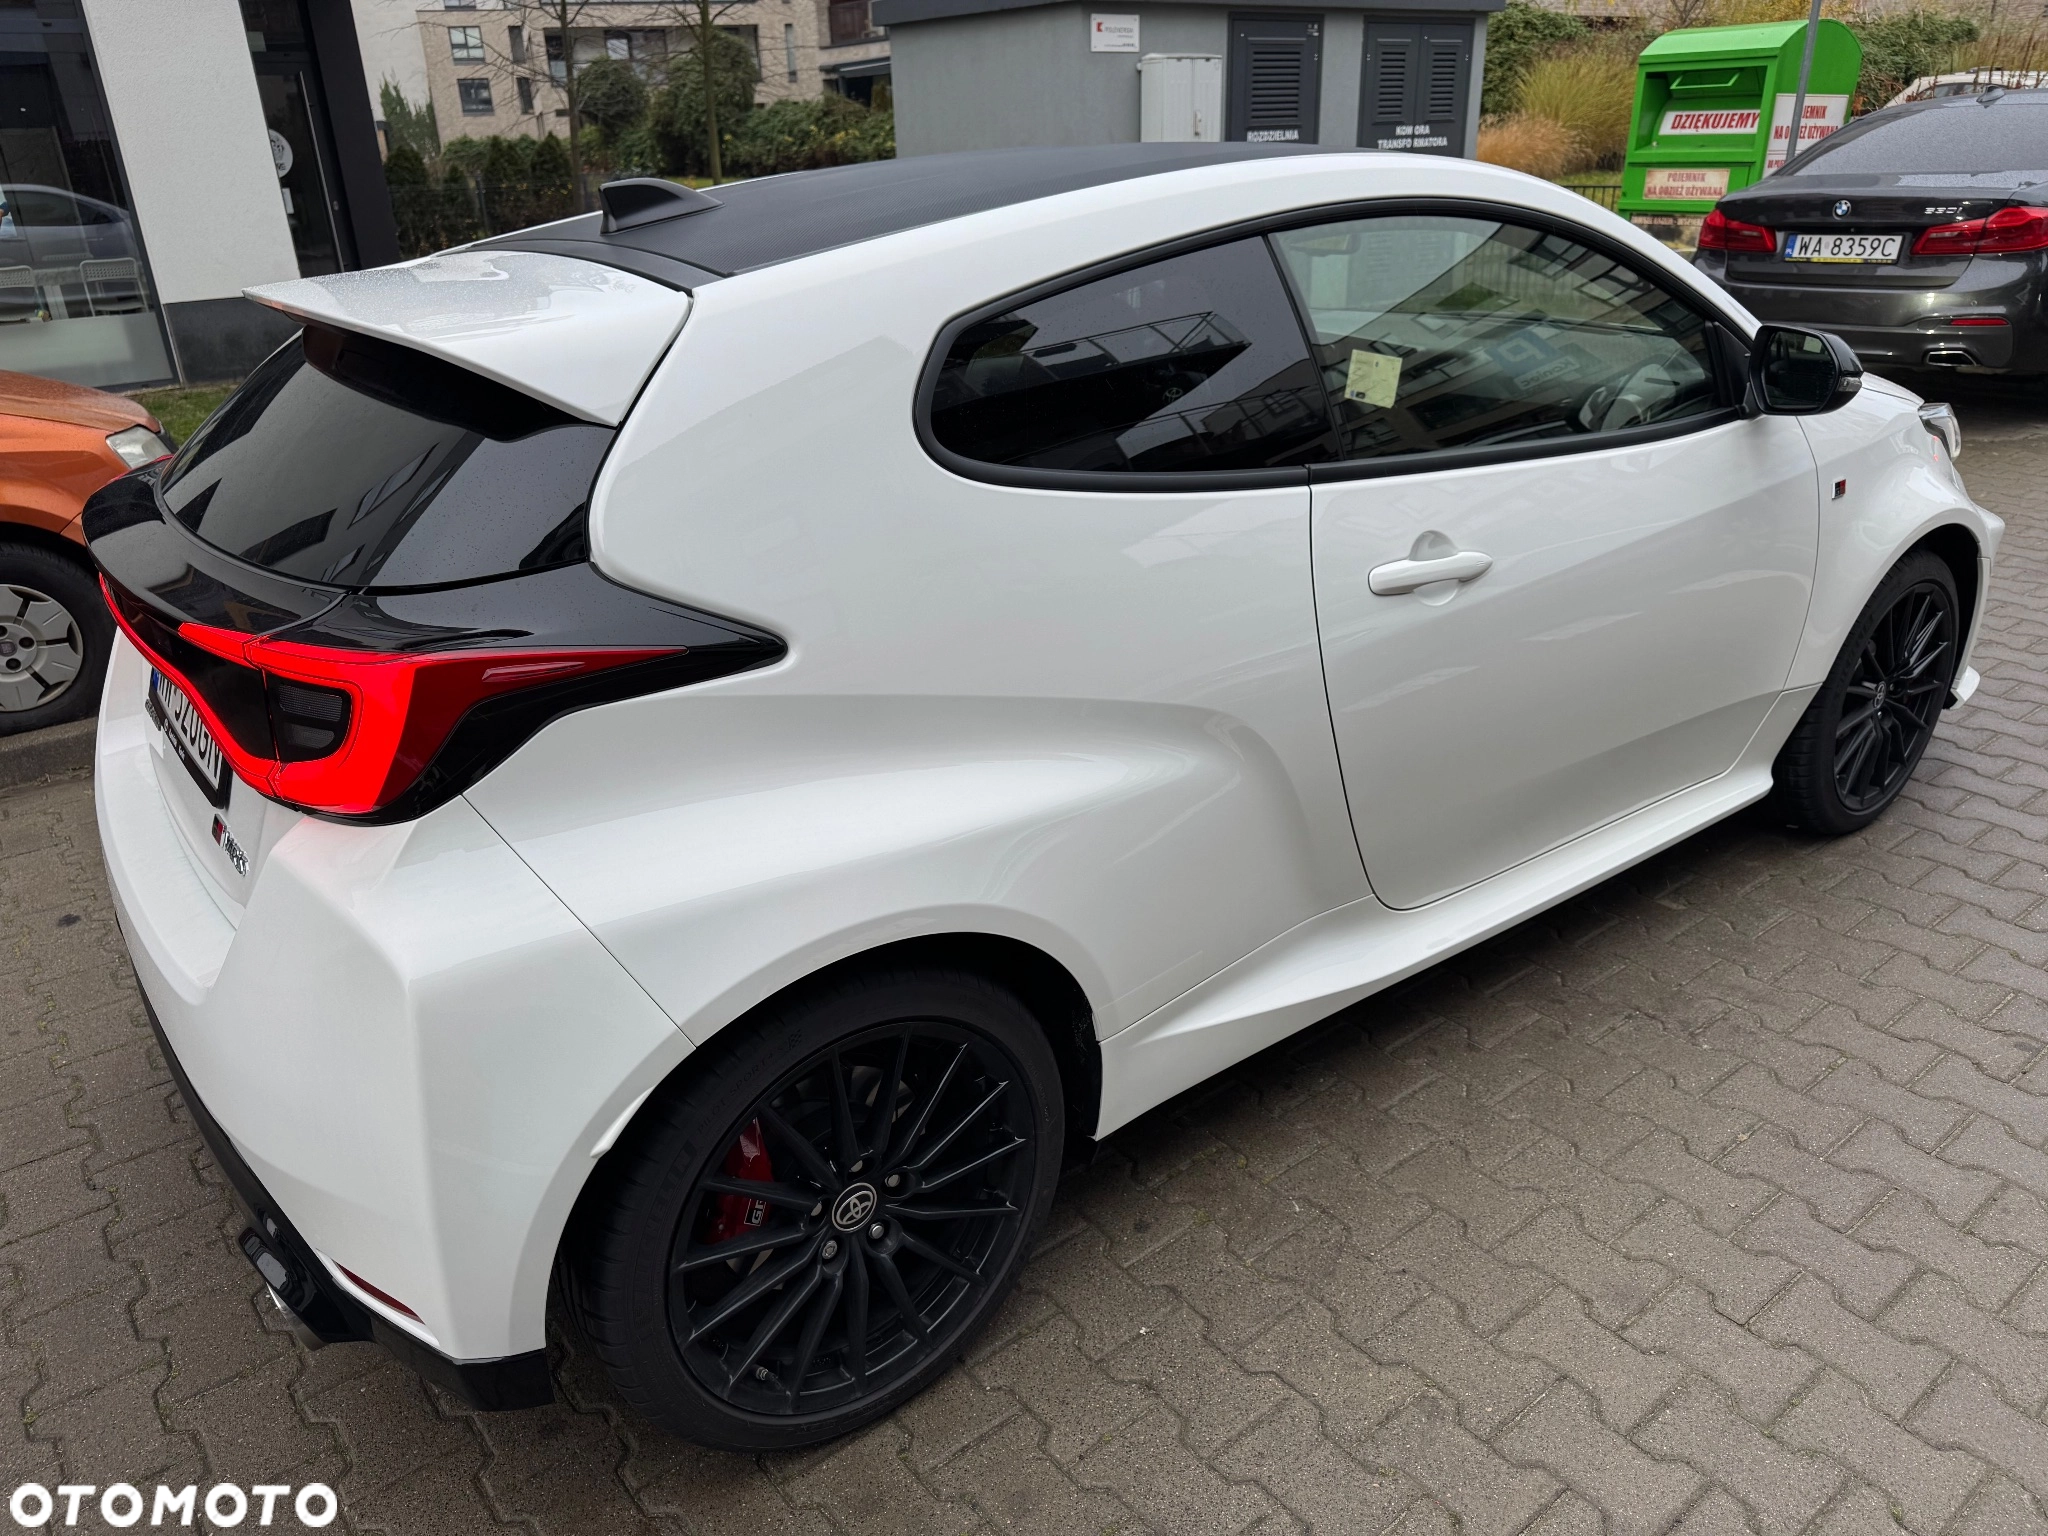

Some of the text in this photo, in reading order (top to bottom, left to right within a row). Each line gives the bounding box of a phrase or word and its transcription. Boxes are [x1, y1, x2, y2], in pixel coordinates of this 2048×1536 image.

[1671, 112, 1760, 132] DZIĘKUJEMY
[1247, 129, 1300, 143] ROZDZIELNIA
[1773, 125, 1784, 139] NA
[1667, 172, 1707, 183] POJEMNIK
[1647, 185, 1657, 196] NA
[1798, 236, 1896, 258] WA 8359C
